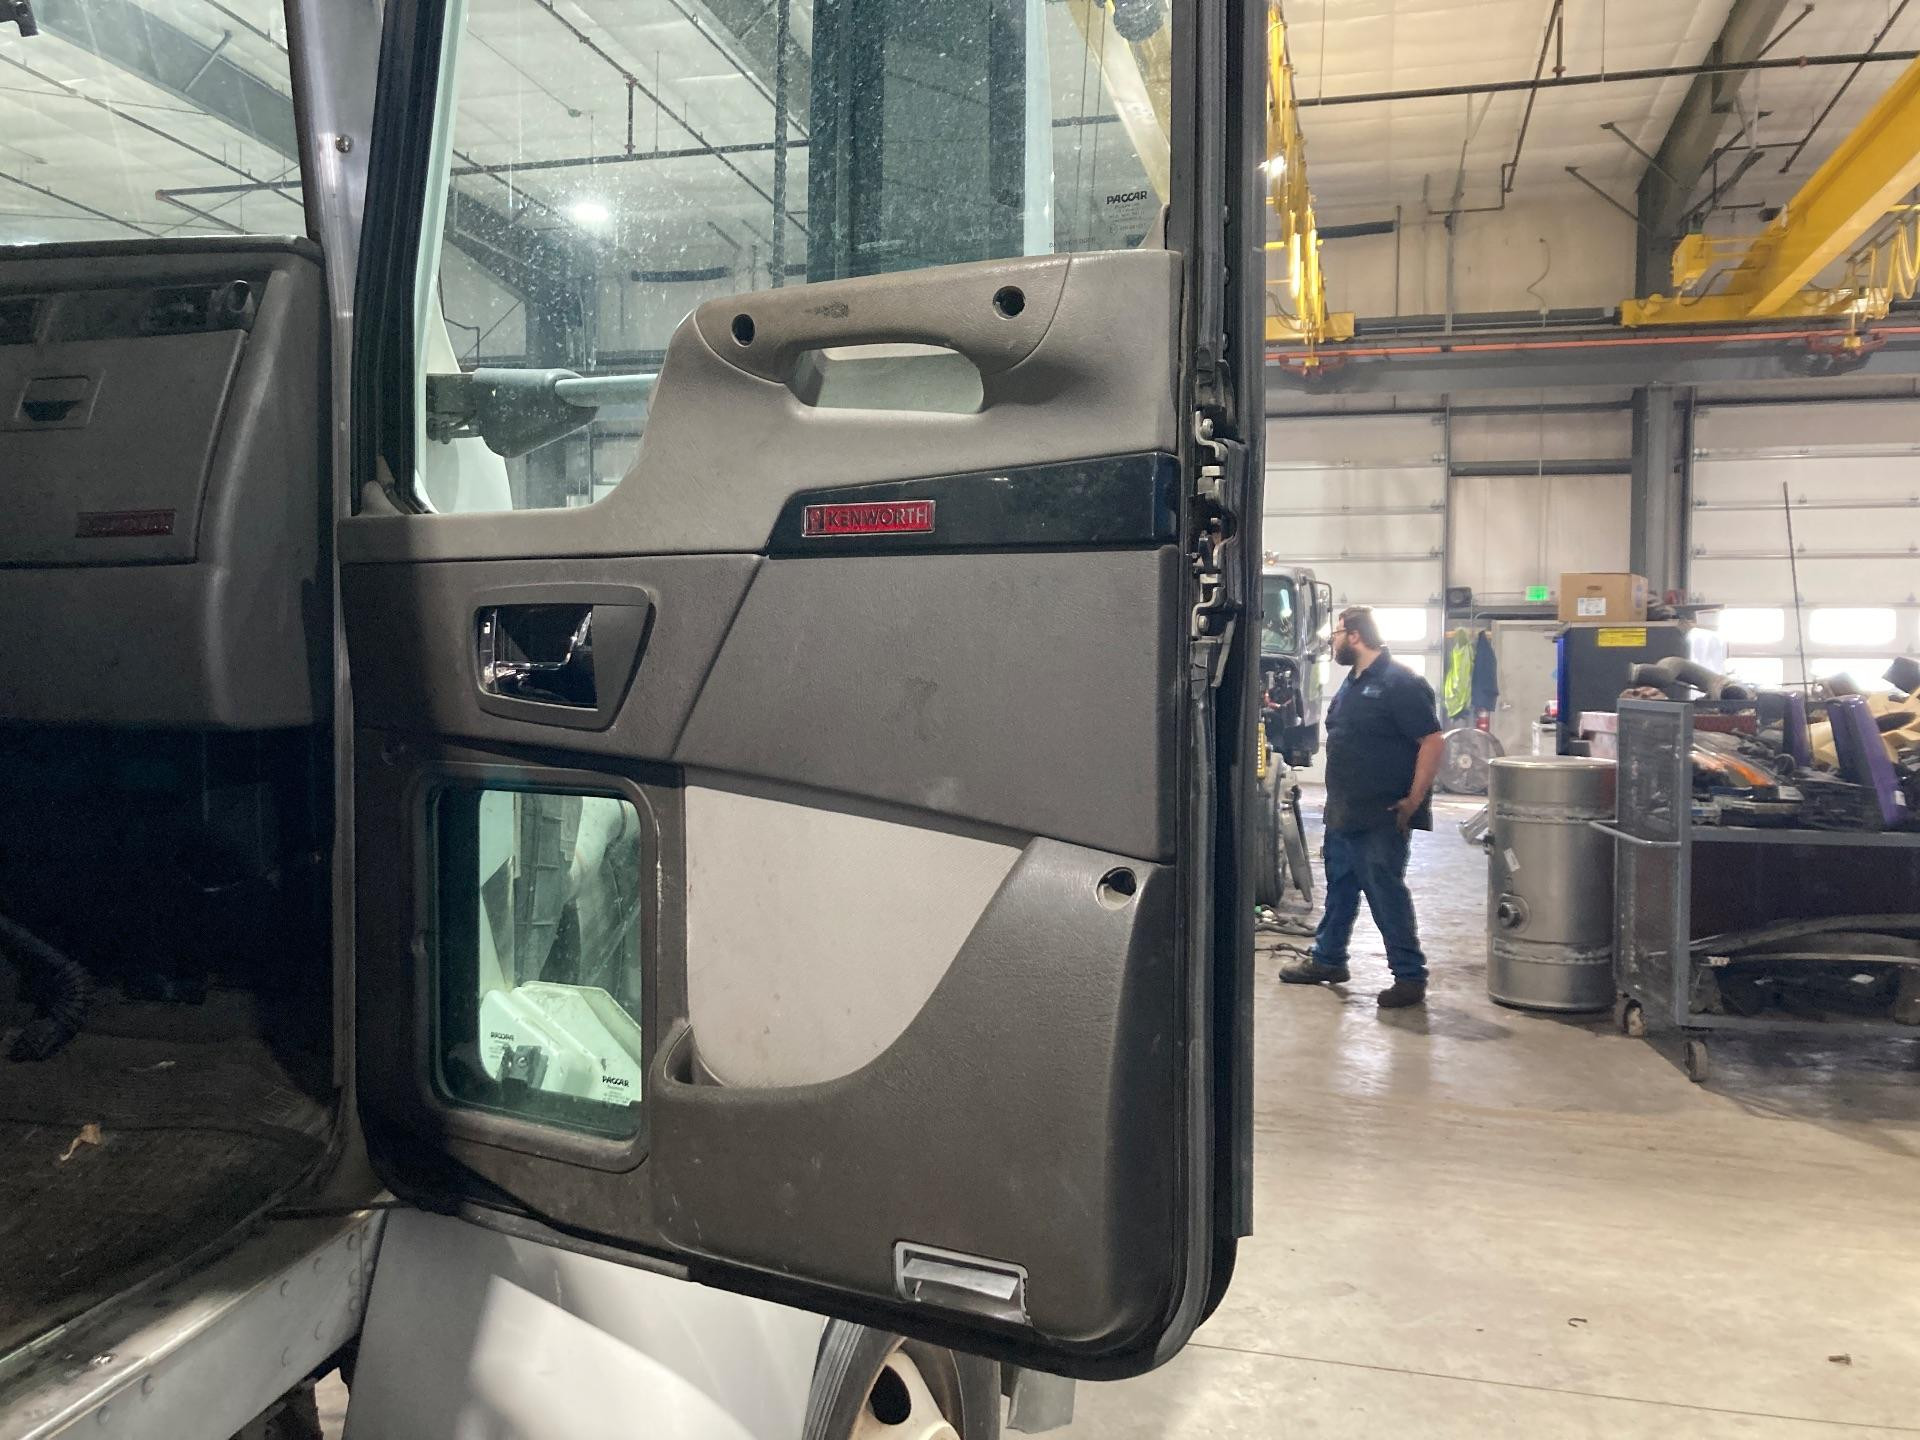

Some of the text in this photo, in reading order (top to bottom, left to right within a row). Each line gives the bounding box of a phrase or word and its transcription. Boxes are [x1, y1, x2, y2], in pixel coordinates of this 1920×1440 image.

[1106, 190, 1148, 204] PACCAR
[829, 507, 928, 527] KENWORTH
[602, 1075, 630, 1087] PACCAR
